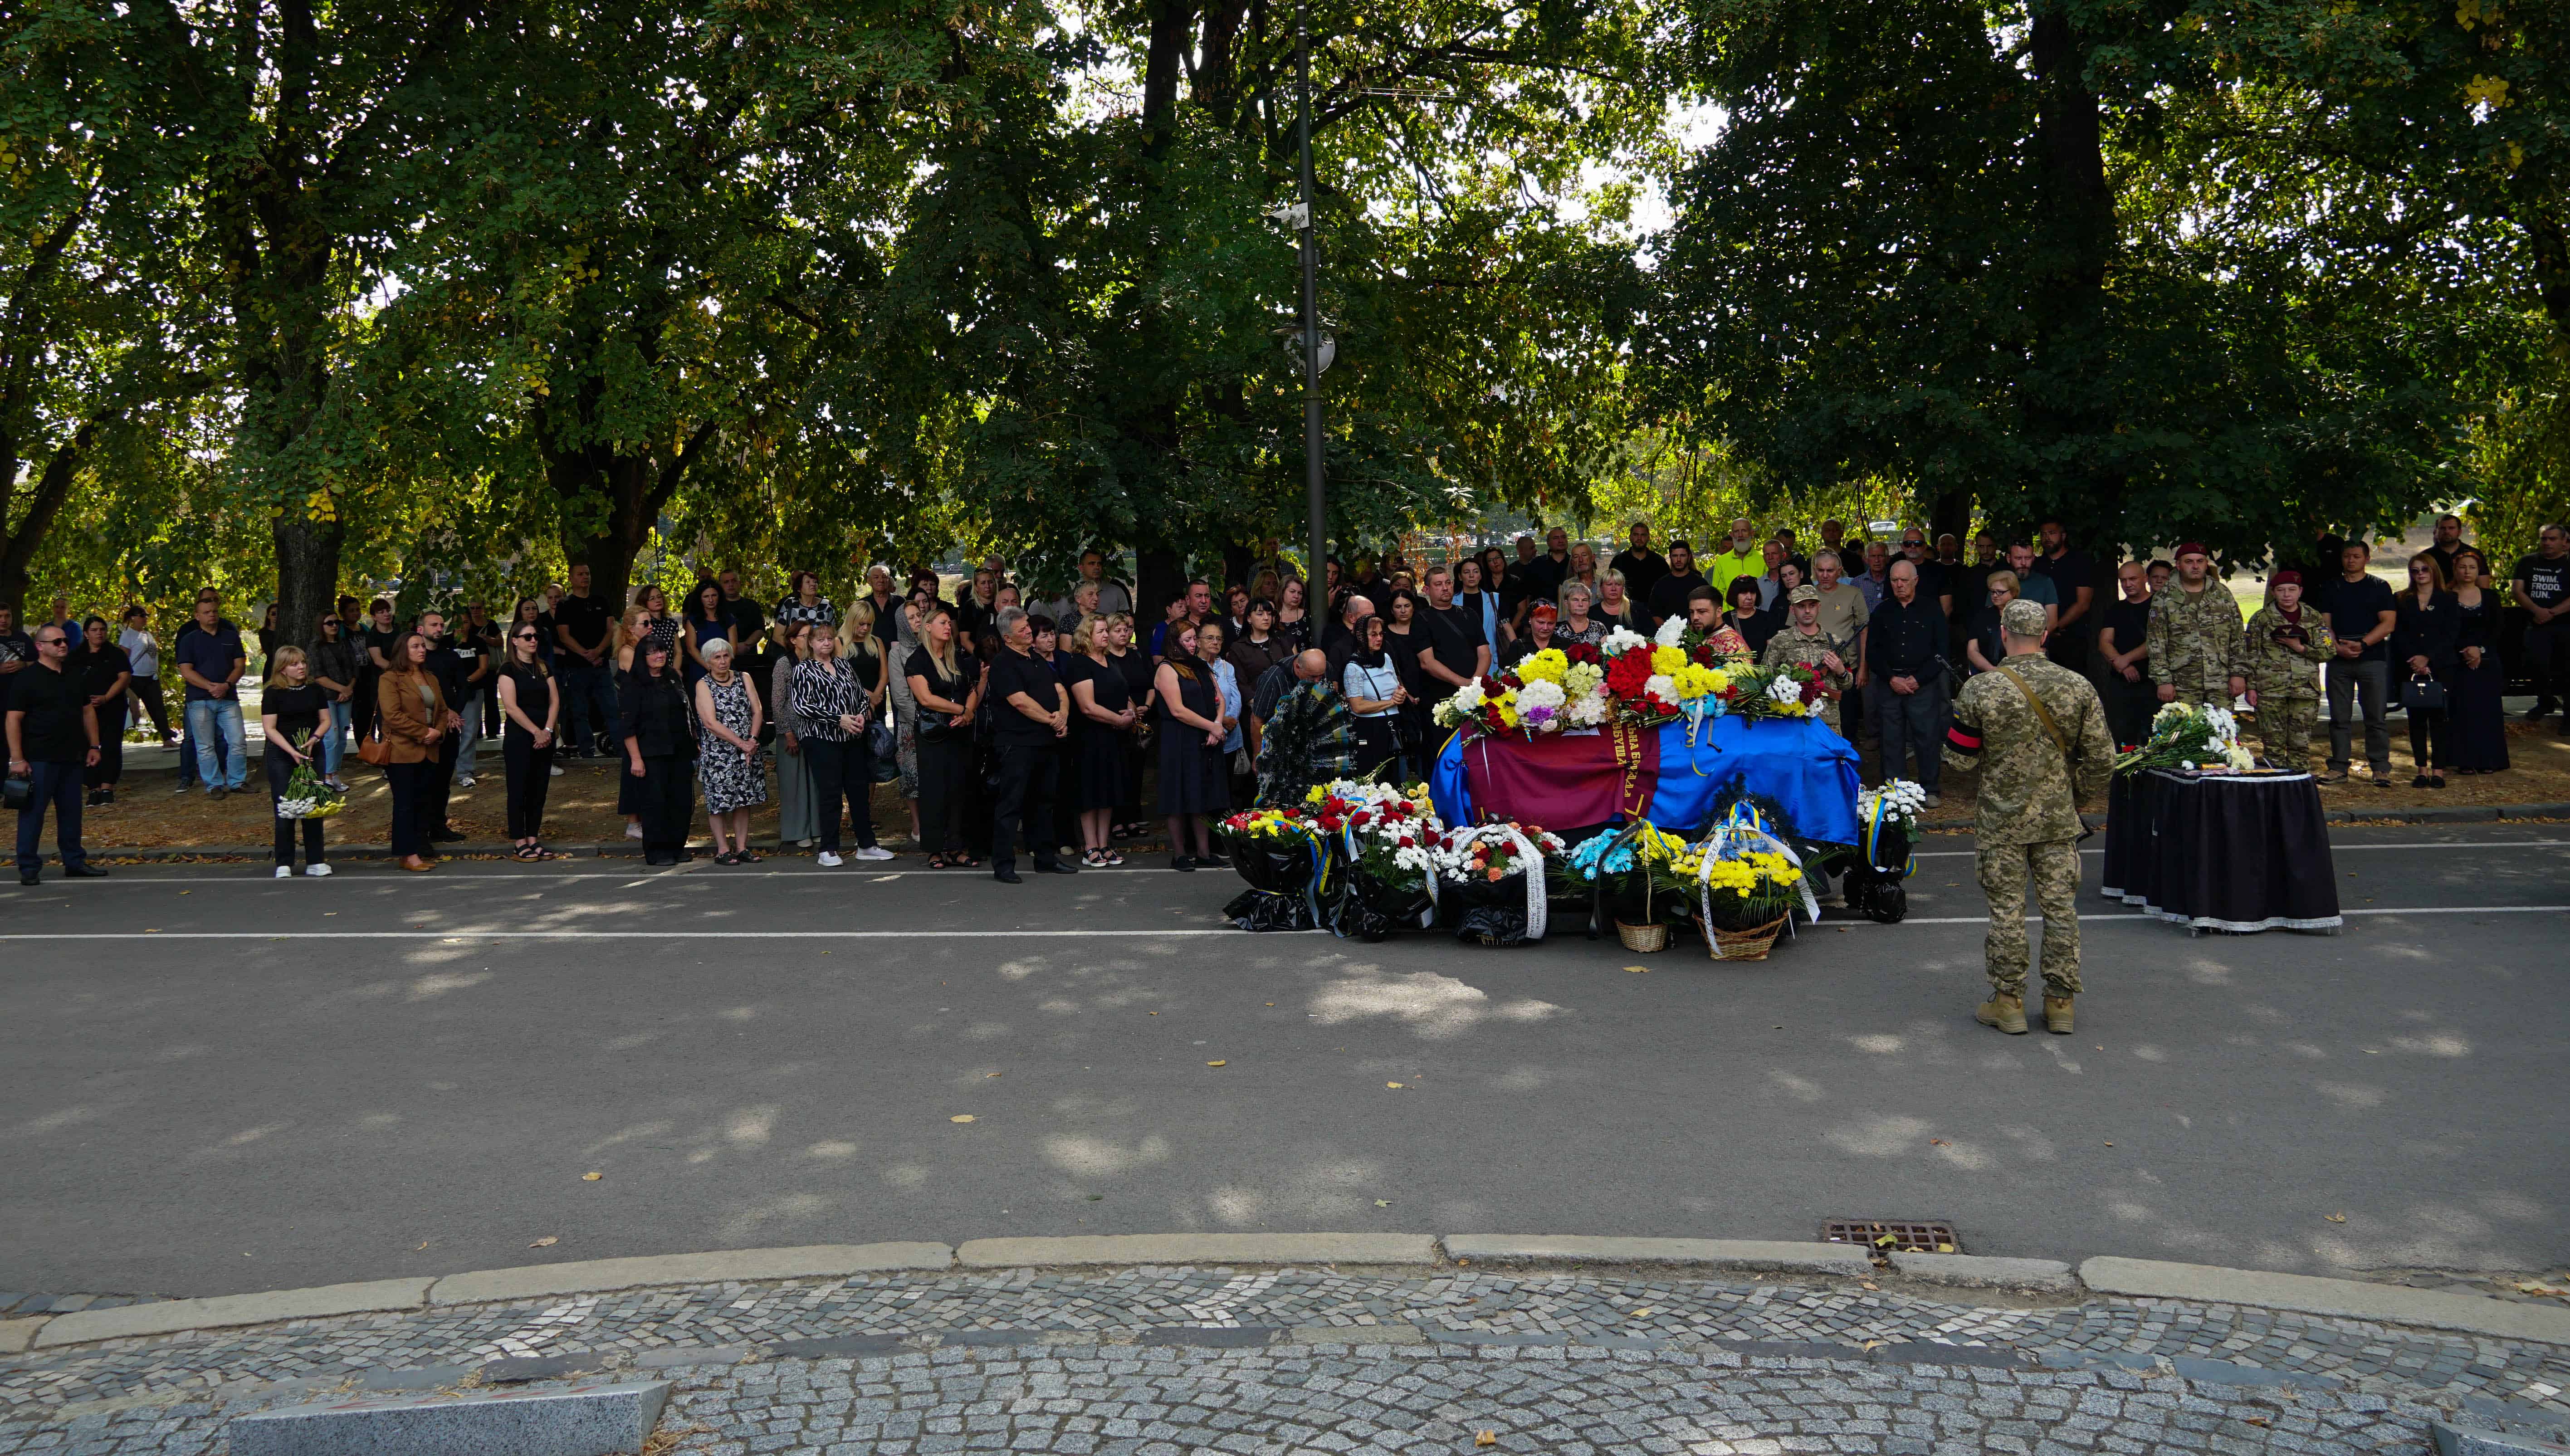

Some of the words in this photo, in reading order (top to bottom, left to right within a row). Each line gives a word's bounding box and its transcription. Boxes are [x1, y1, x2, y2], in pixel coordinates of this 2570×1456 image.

[2532, 574, 2559, 583] SWIM.
[2532, 582, 2562, 591] FRODO.
[1612, 722, 1627, 765] ВБУША
[1627, 722, 1639, 750] ЛЬНА
[1624, 752, 1641, 797] БРИАДА
